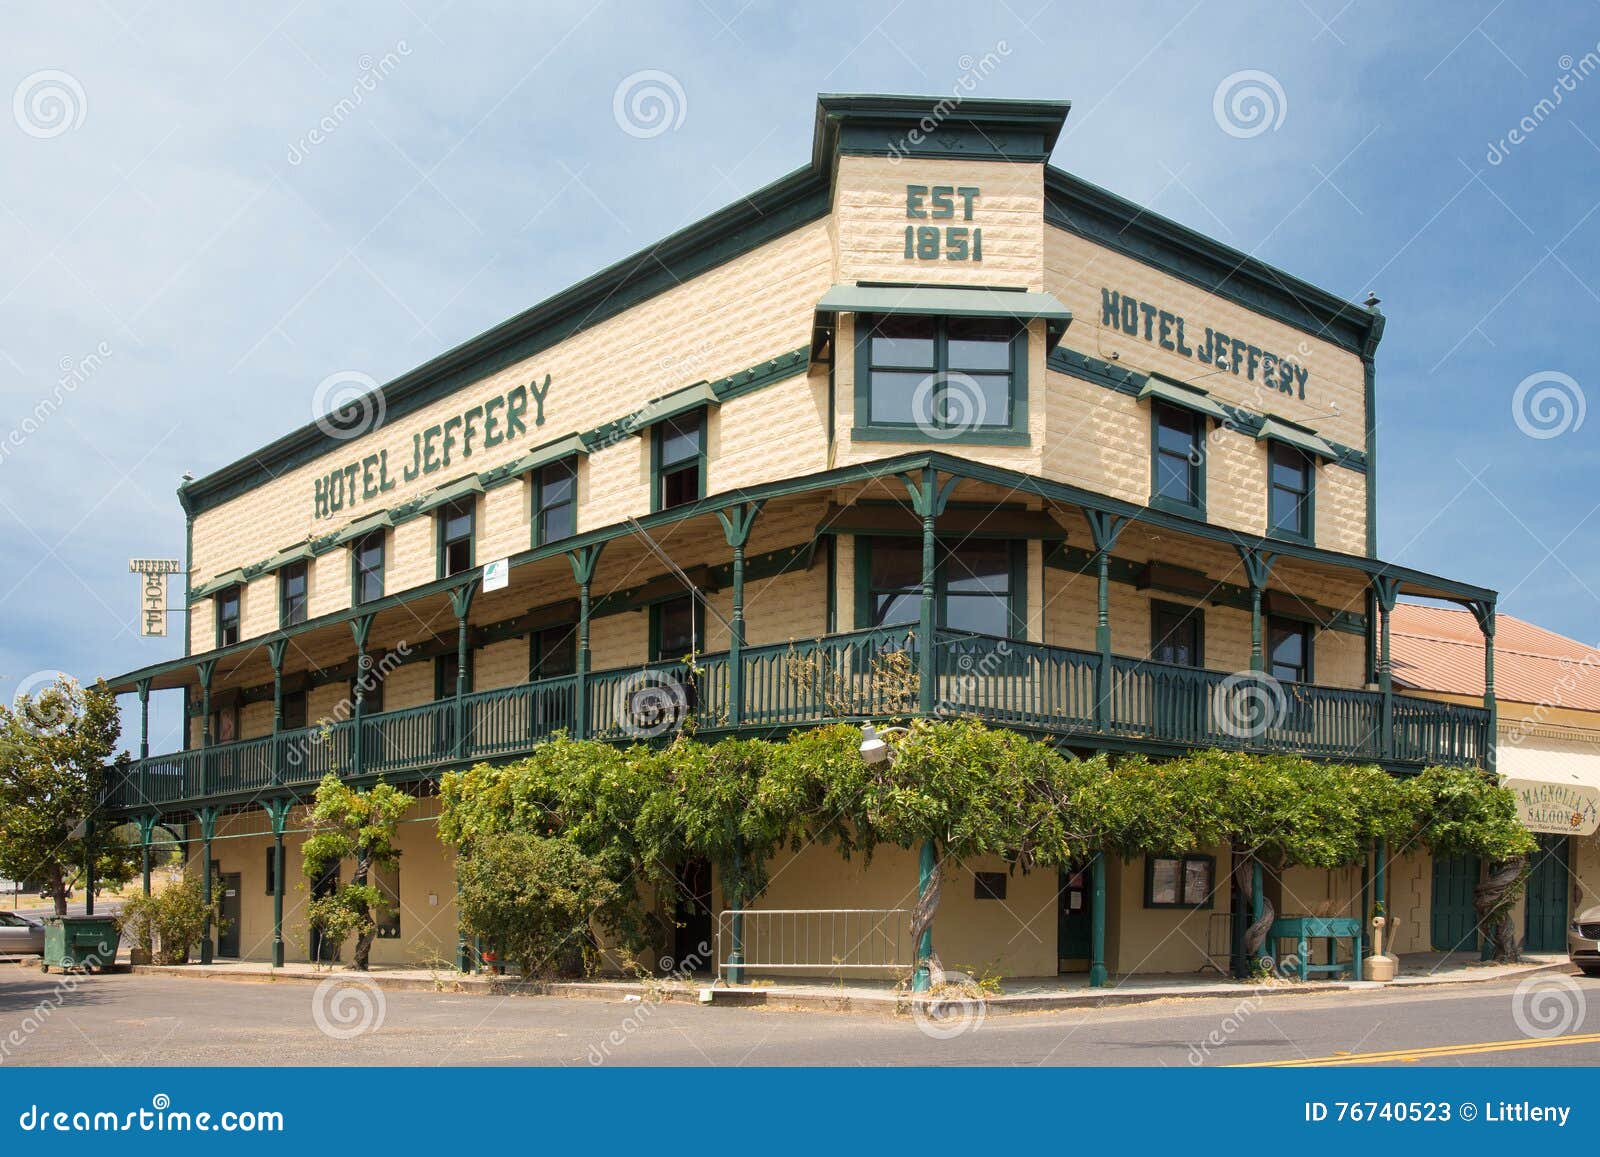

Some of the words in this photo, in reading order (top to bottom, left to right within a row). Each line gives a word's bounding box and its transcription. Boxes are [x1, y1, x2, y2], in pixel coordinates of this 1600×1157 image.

[907, 185, 979, 220] EST
[904, 226, 982, 261] 1851
[1101, 287, 1192, 357] HOTEL
[1197, 327, 1308, 400] JEFFERY
[314, 449, 396, 519] HOTEL
[403, 373, 551, 482] JEFFERY
[130, 559, 178, 572] JEFFERY
[145, 572, 162, 635] HOTEL
[1527, 807, 1571, 825] SALOON
